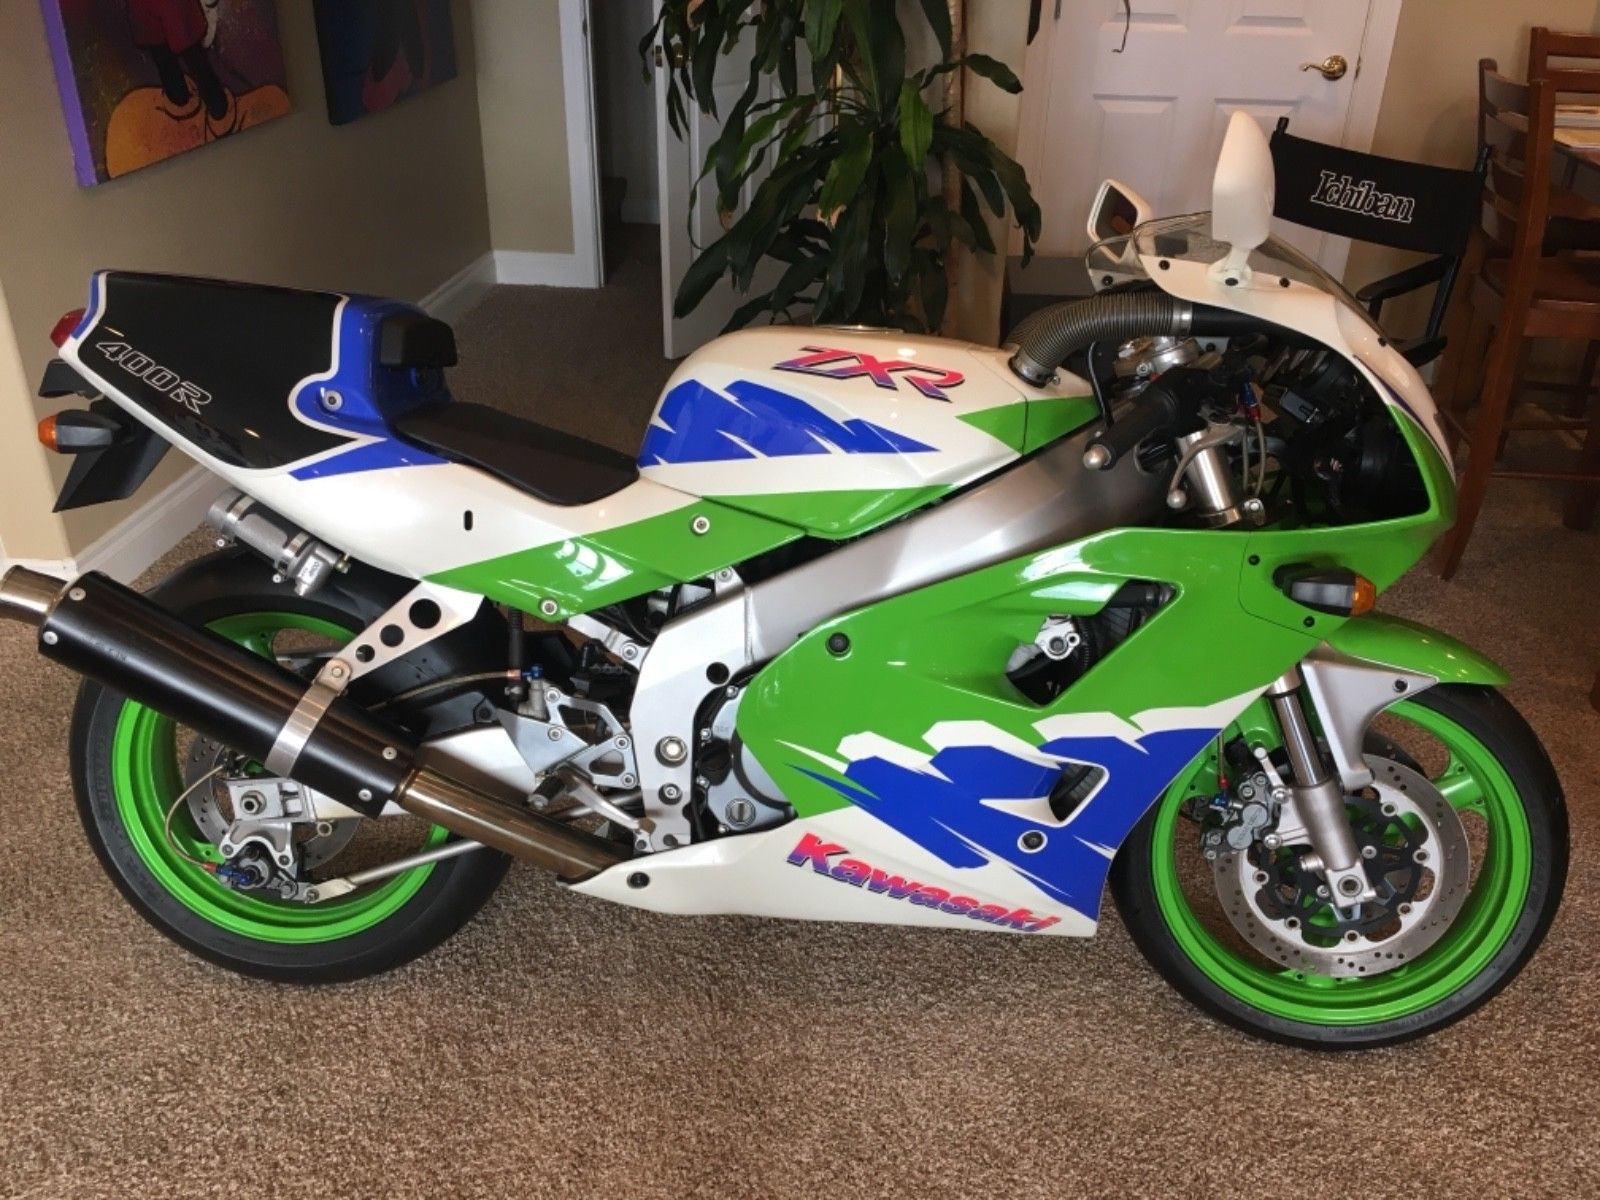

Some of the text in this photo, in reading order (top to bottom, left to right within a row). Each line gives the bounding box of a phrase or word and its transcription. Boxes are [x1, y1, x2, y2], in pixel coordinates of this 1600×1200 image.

[1310, 169, 1415, 223] Ichiban
[95, 342, 212, 414] 400R
[771, 345, 965, 403] ZXR
[786, 832, 1062, 932] Kawasaki
